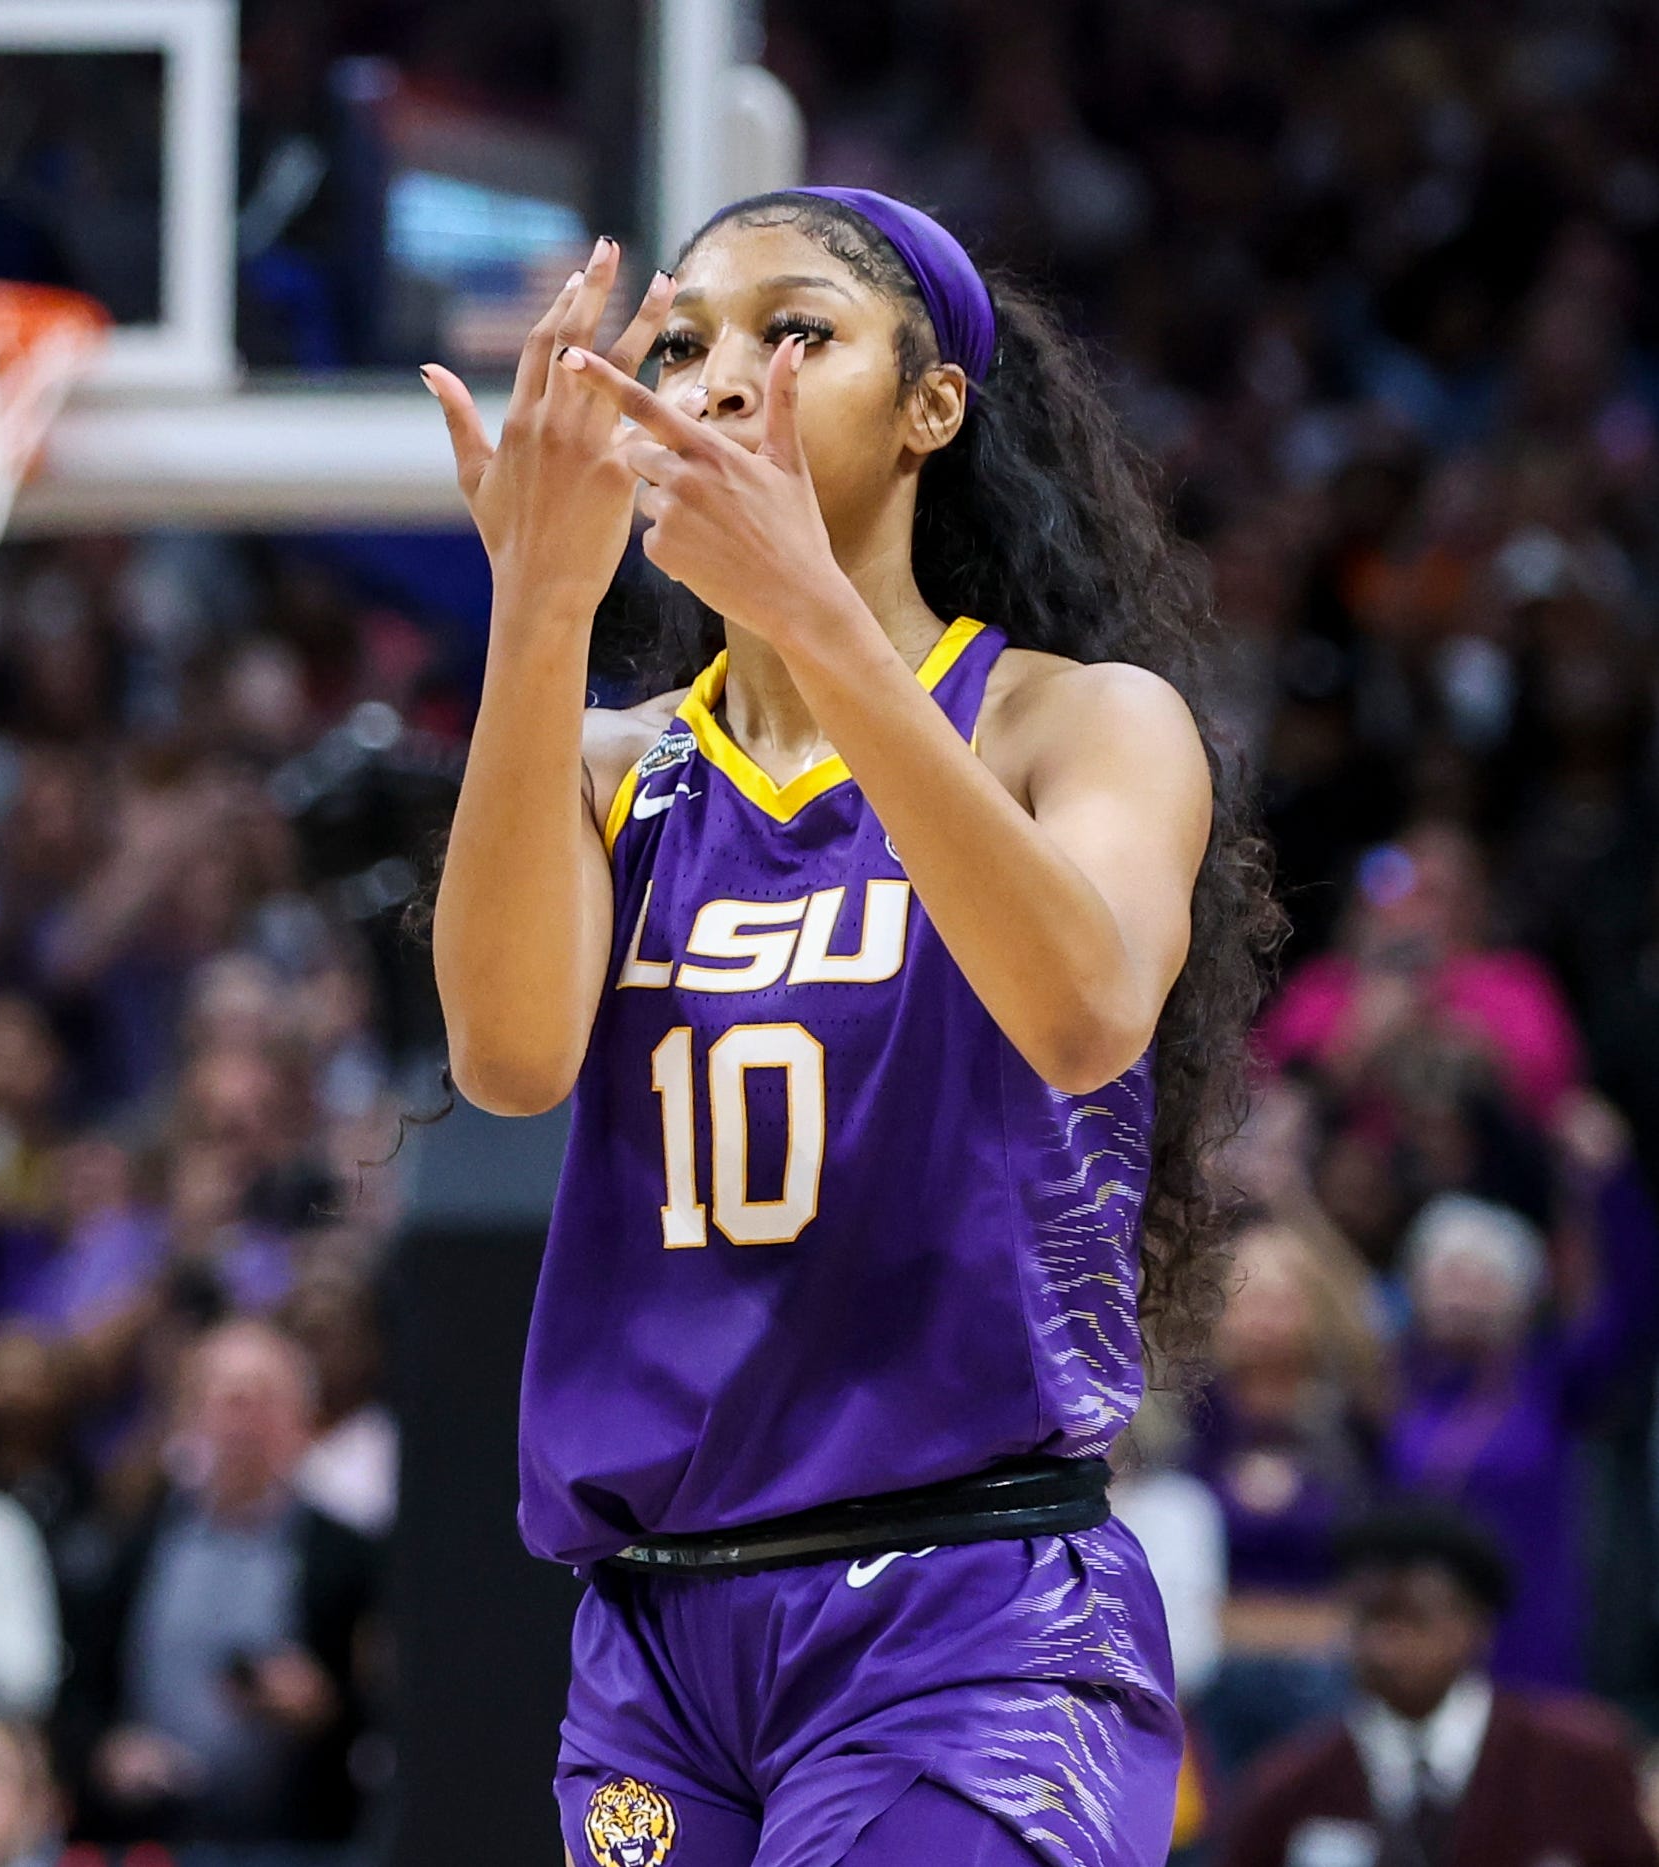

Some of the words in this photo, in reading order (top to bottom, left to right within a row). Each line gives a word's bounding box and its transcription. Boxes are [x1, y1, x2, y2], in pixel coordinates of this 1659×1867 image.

[664, 739, 692, 754] FOUR
[616, 880, 911, 993] LSU
[652, 1022, 824, 1249] 10
